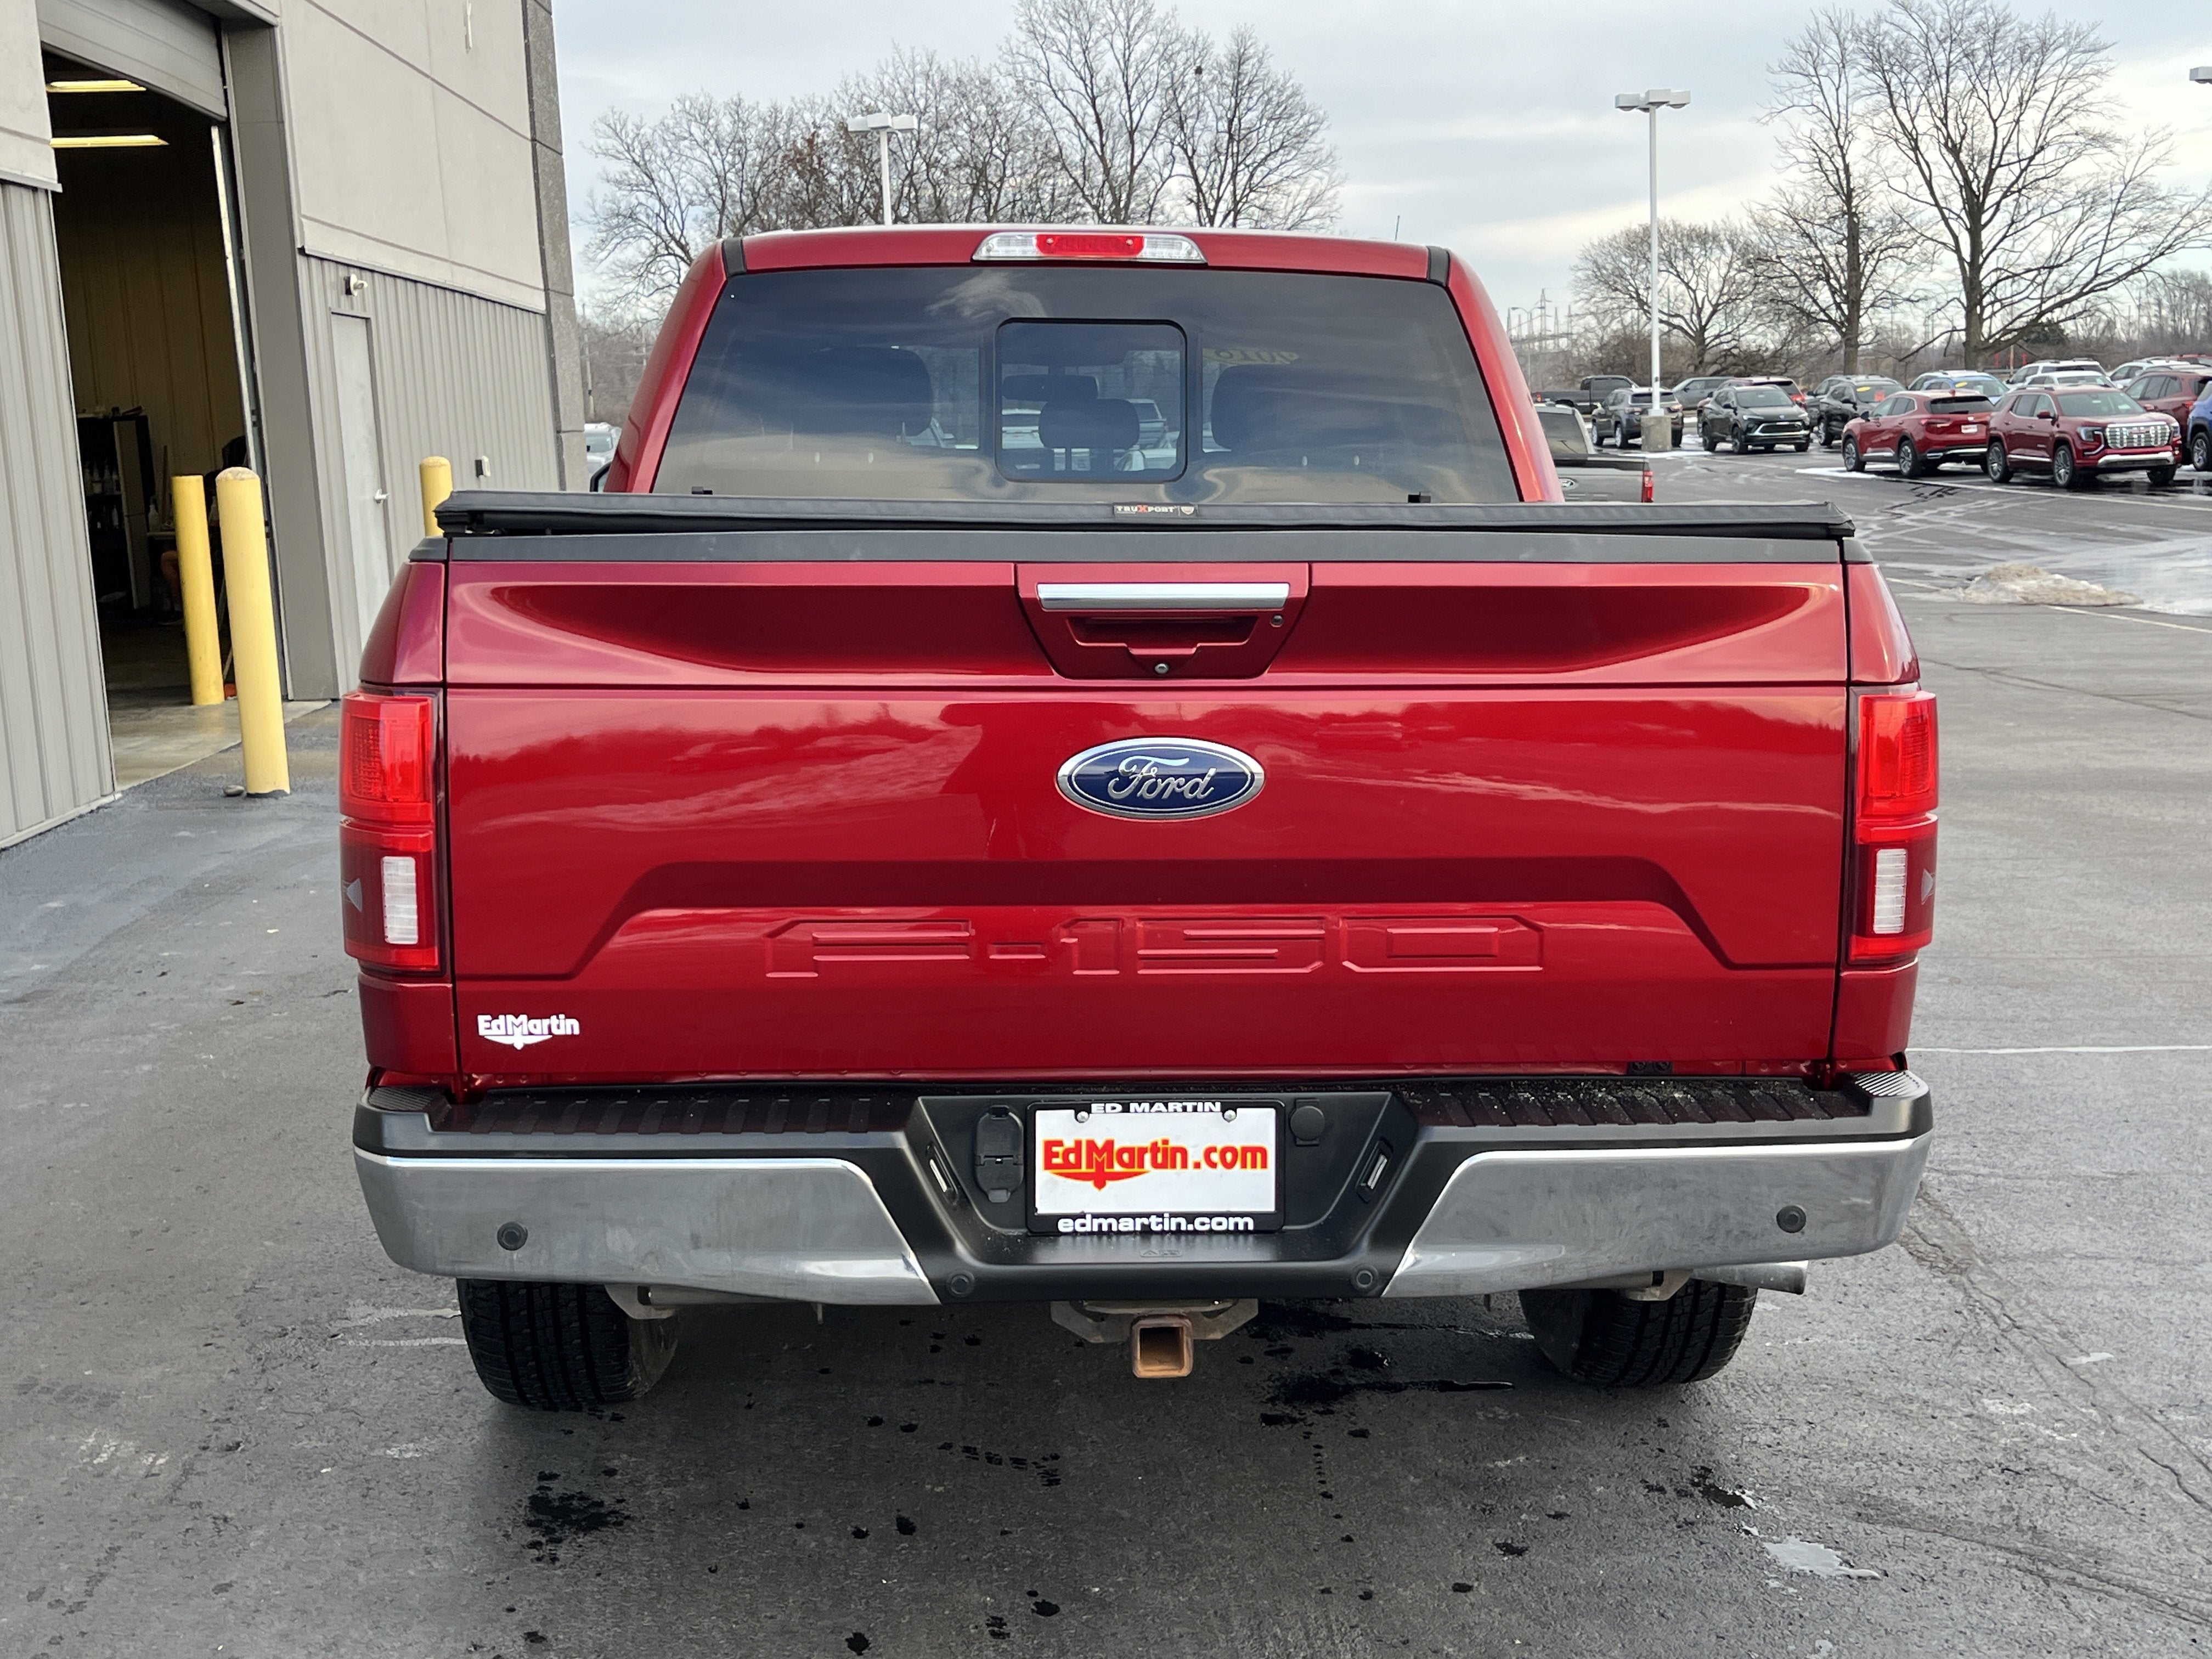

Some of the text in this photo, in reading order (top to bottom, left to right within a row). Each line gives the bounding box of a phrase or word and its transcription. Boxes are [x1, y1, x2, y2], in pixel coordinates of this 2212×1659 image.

[1107, 755, 1217, 800] Ford
[764, 917, 1544, 978] F-150
[477, 1014, 580, 1036] EdMartin
[1091, 1102, 1221, 1113] ED MARTIN
[1057, 1213, 1255, 1233] edmartin.com
